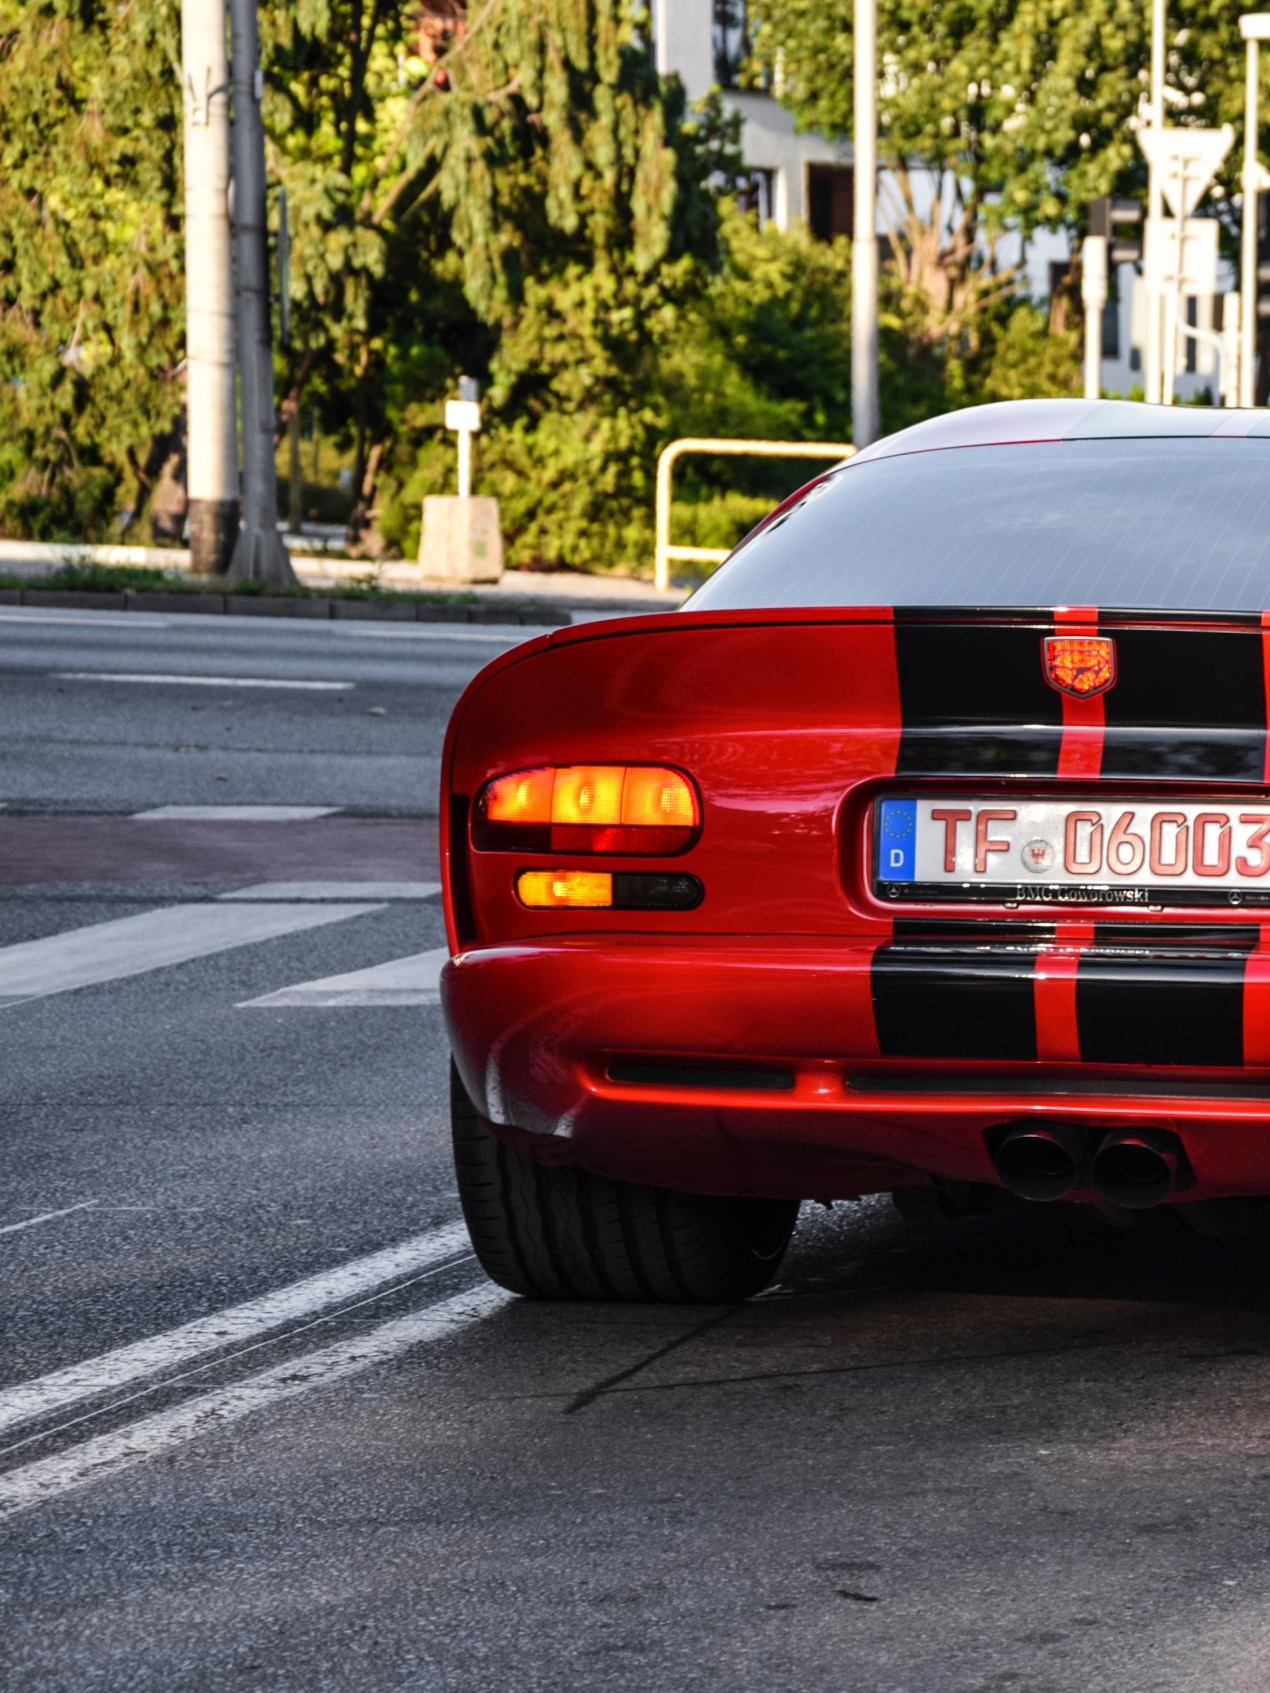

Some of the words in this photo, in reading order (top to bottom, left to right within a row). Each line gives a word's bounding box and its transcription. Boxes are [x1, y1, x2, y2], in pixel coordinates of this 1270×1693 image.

[931, 809, 1017, 873] TF
[889, 848, 904, 867] D
[1016, 886, 1053, 901] BMG
